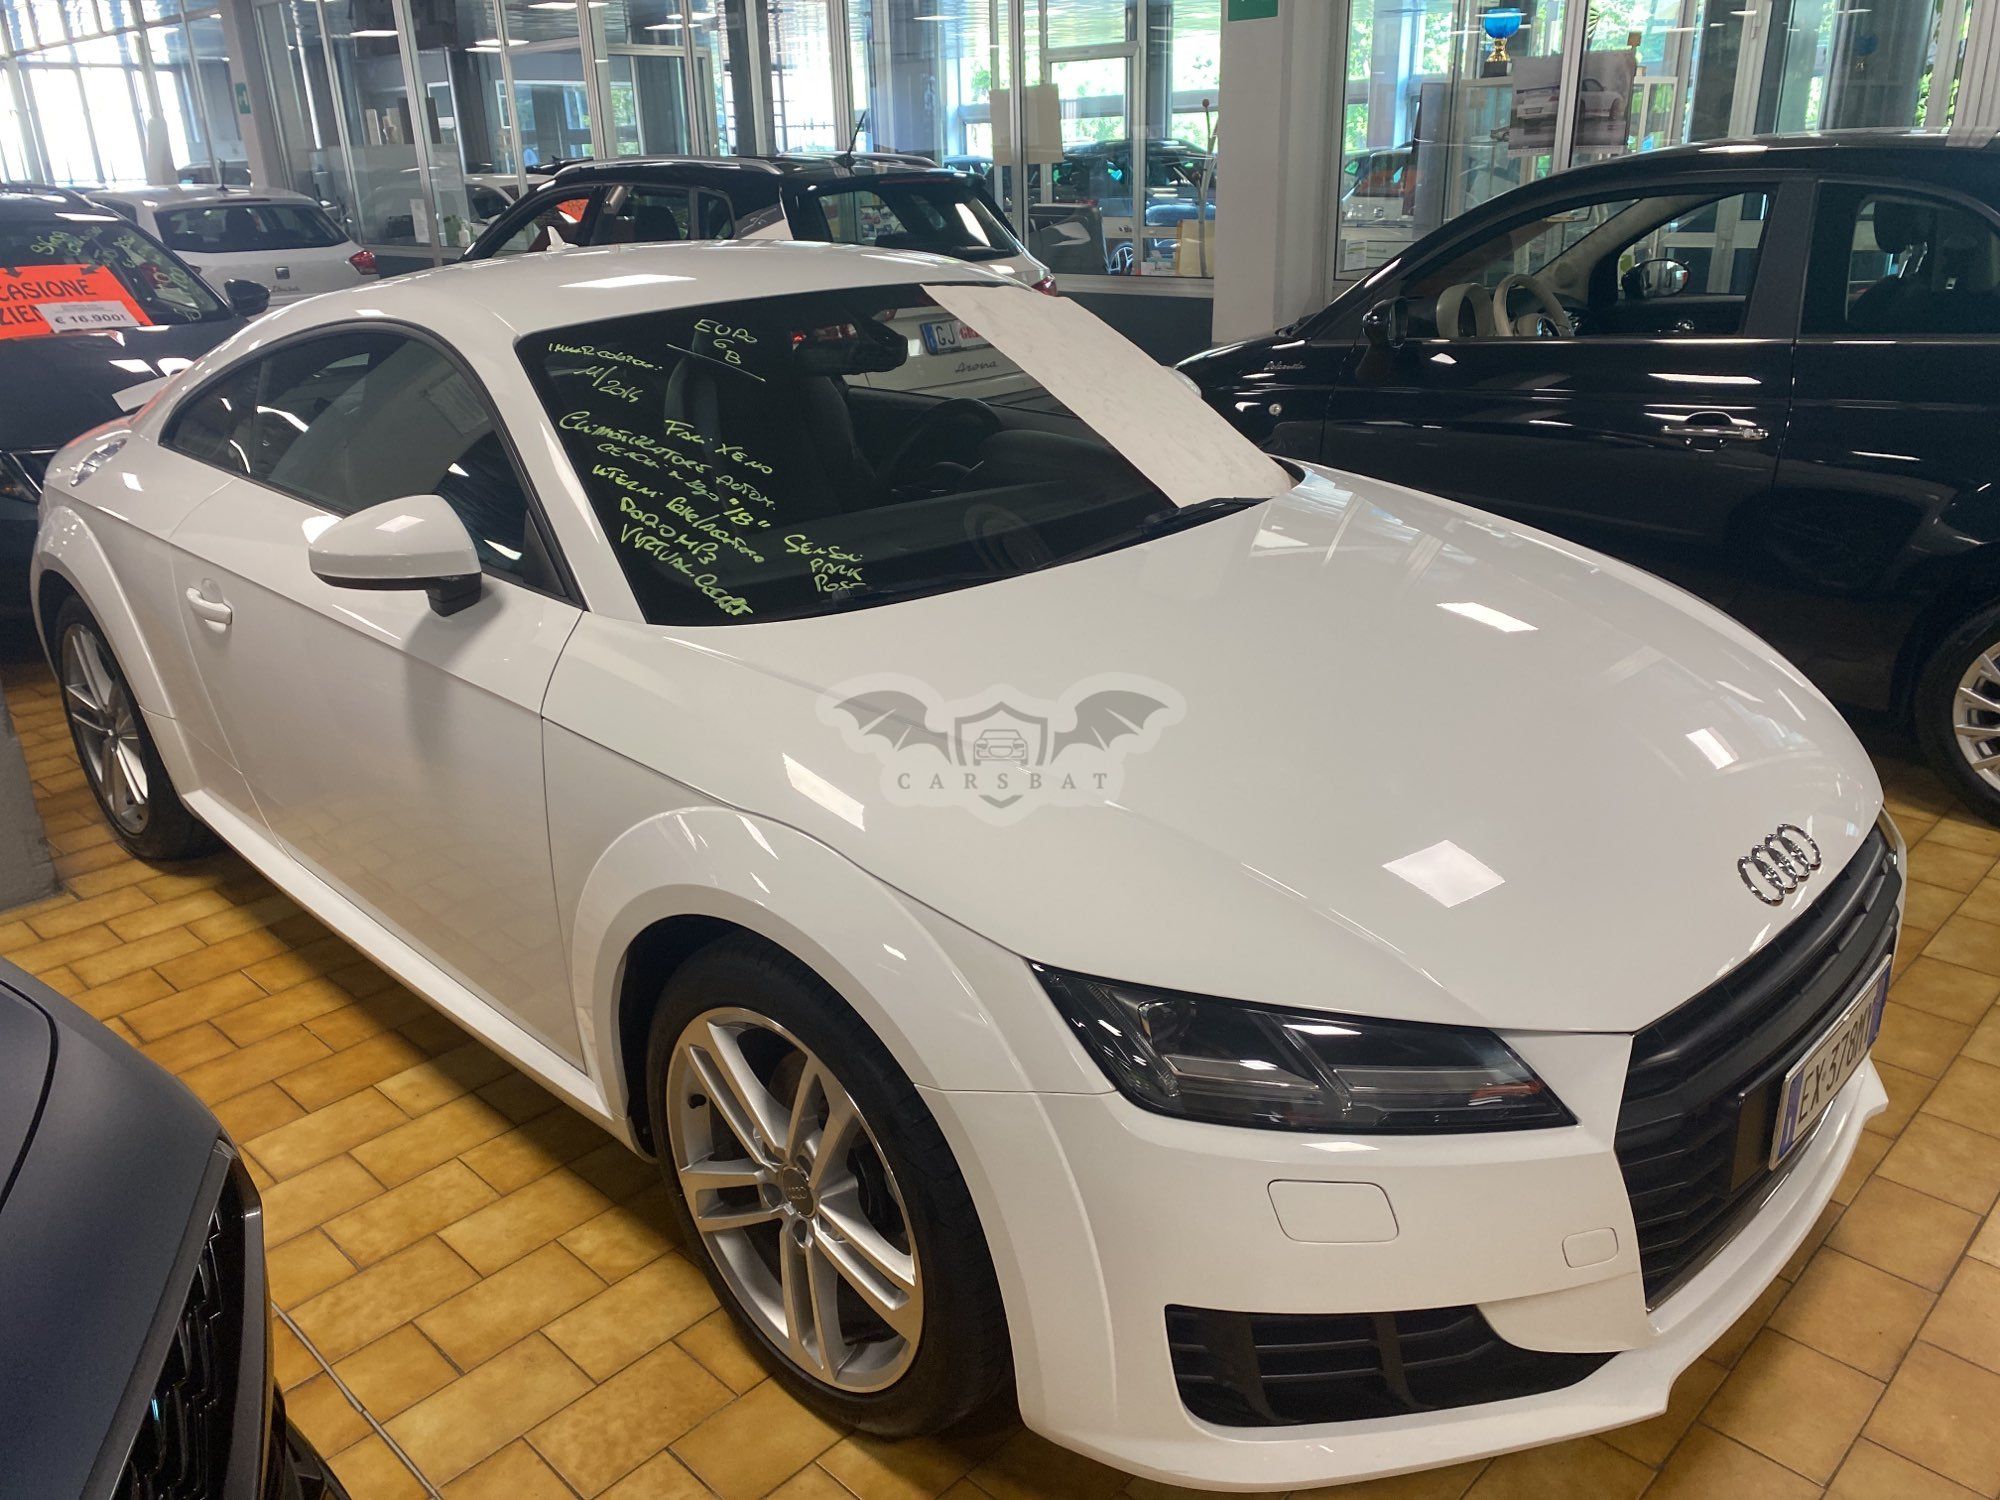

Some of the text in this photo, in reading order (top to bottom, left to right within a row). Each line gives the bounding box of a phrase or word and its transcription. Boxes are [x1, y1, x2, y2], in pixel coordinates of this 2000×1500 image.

[935, 323, 956, 346] GJ
[725, 350, 741, 364] B
[955, 361, 999, 374] Arona
